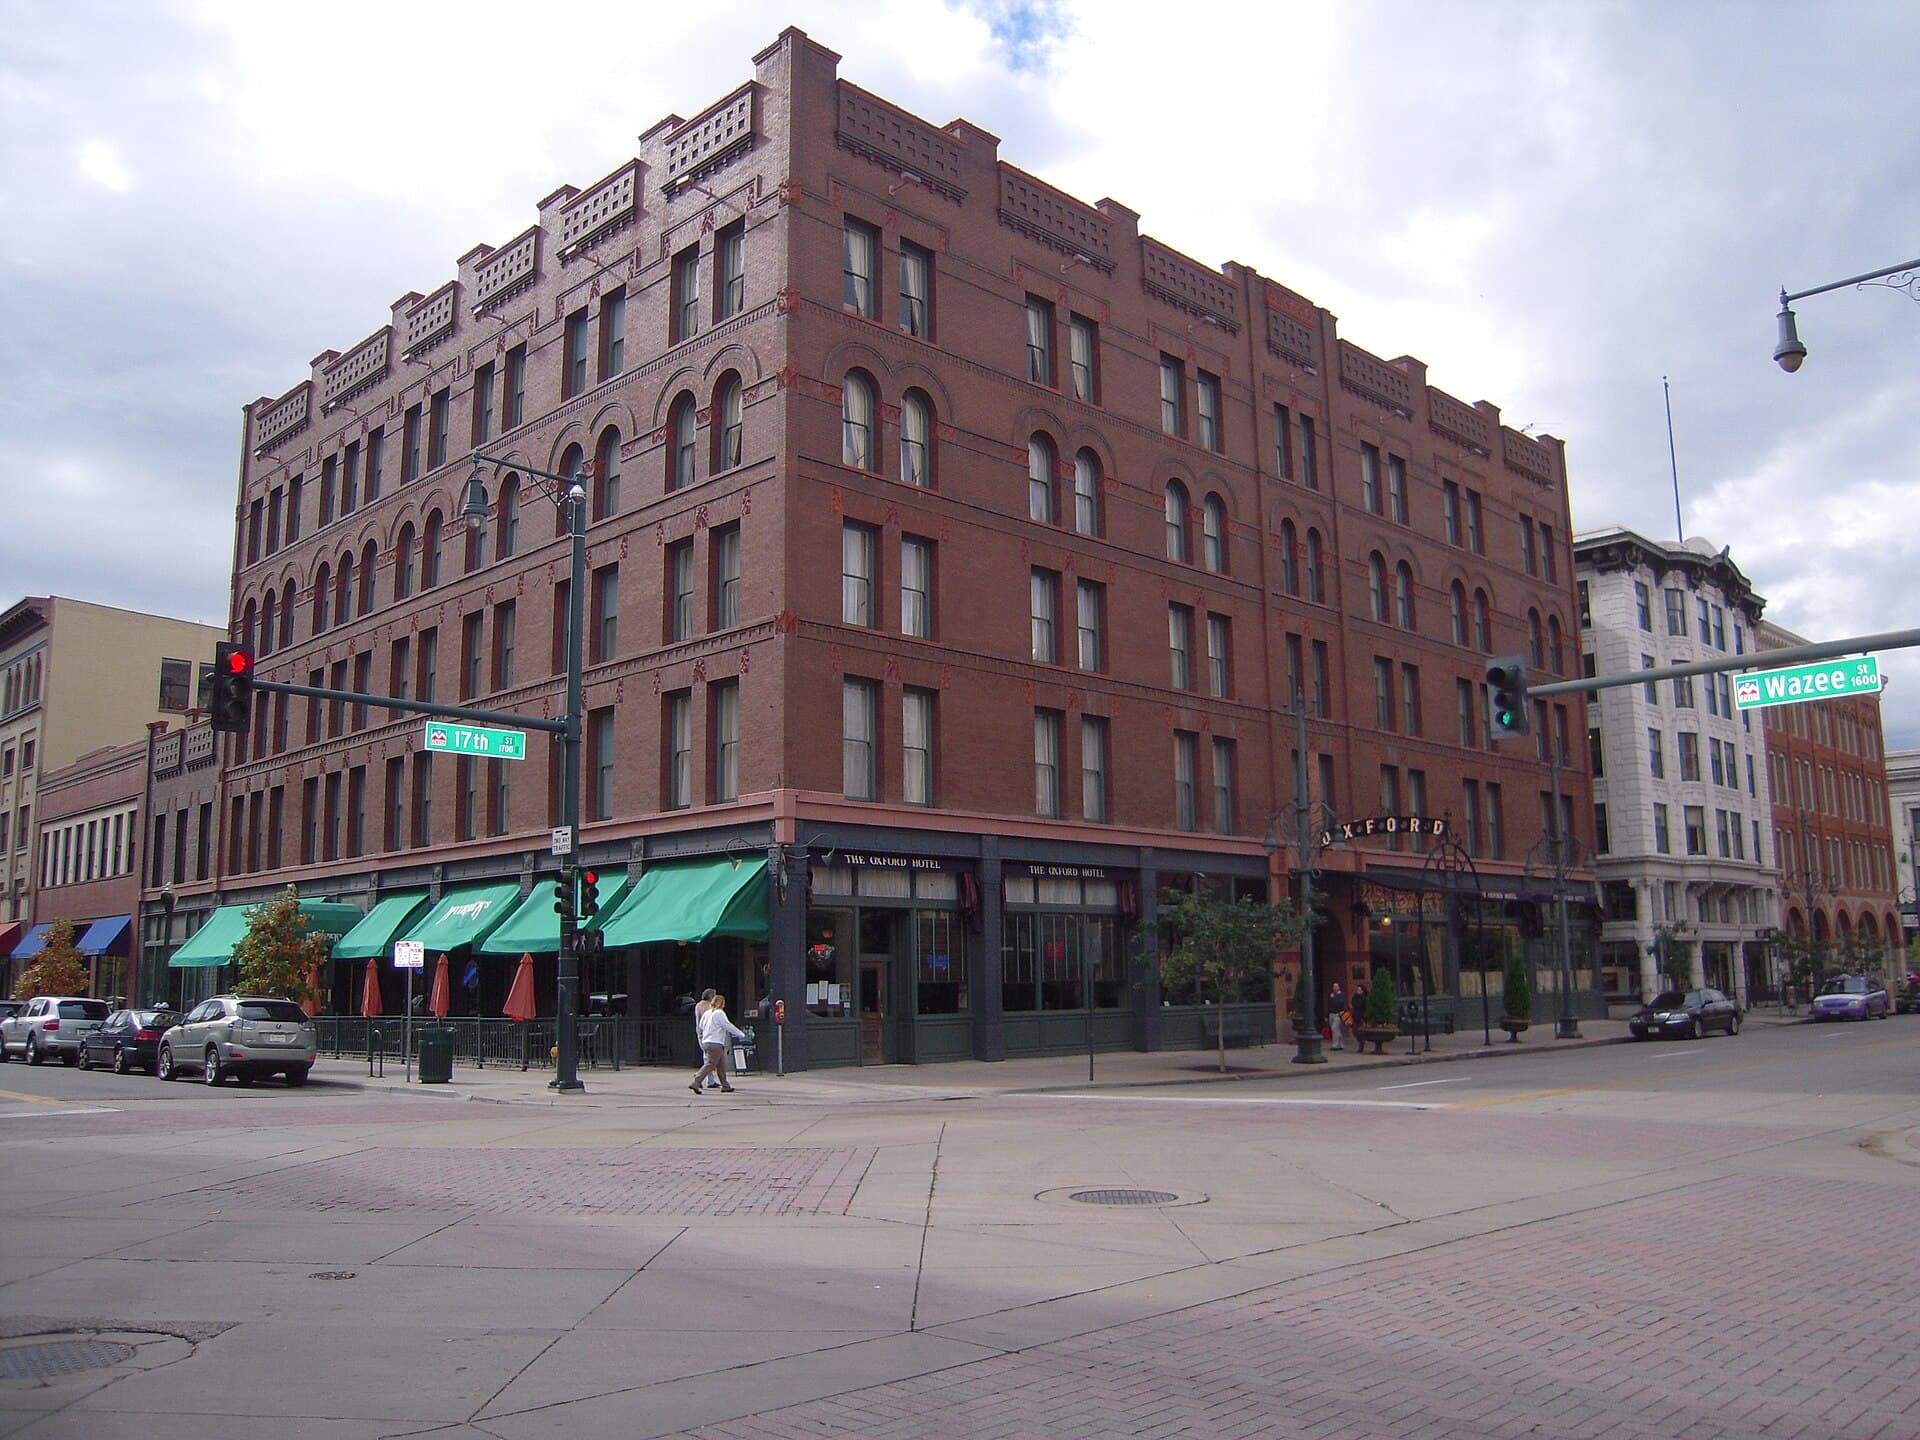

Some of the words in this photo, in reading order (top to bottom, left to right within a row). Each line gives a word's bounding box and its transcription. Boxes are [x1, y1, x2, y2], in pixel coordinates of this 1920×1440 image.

[1857, 664, 1868, 674] St
[1764, 670, 1845, 698] Wazee
[1851, 674, 1876, 687] 1600
[455, 731, 488, 750] 17th
[499, 744, 513, 753] 1700
[553, 843, 570, 852] TRAFFIC
[844, 854, 866, 865] THE
[869, 856, 907, 867] OXFORD
[912, 858, 941, 869] HOTEL
[1028, 865, 1045, 875] THE
[1048, 866, 1078, 877] OXFORD
[1082, 867, 1105, 878] HOTEL
